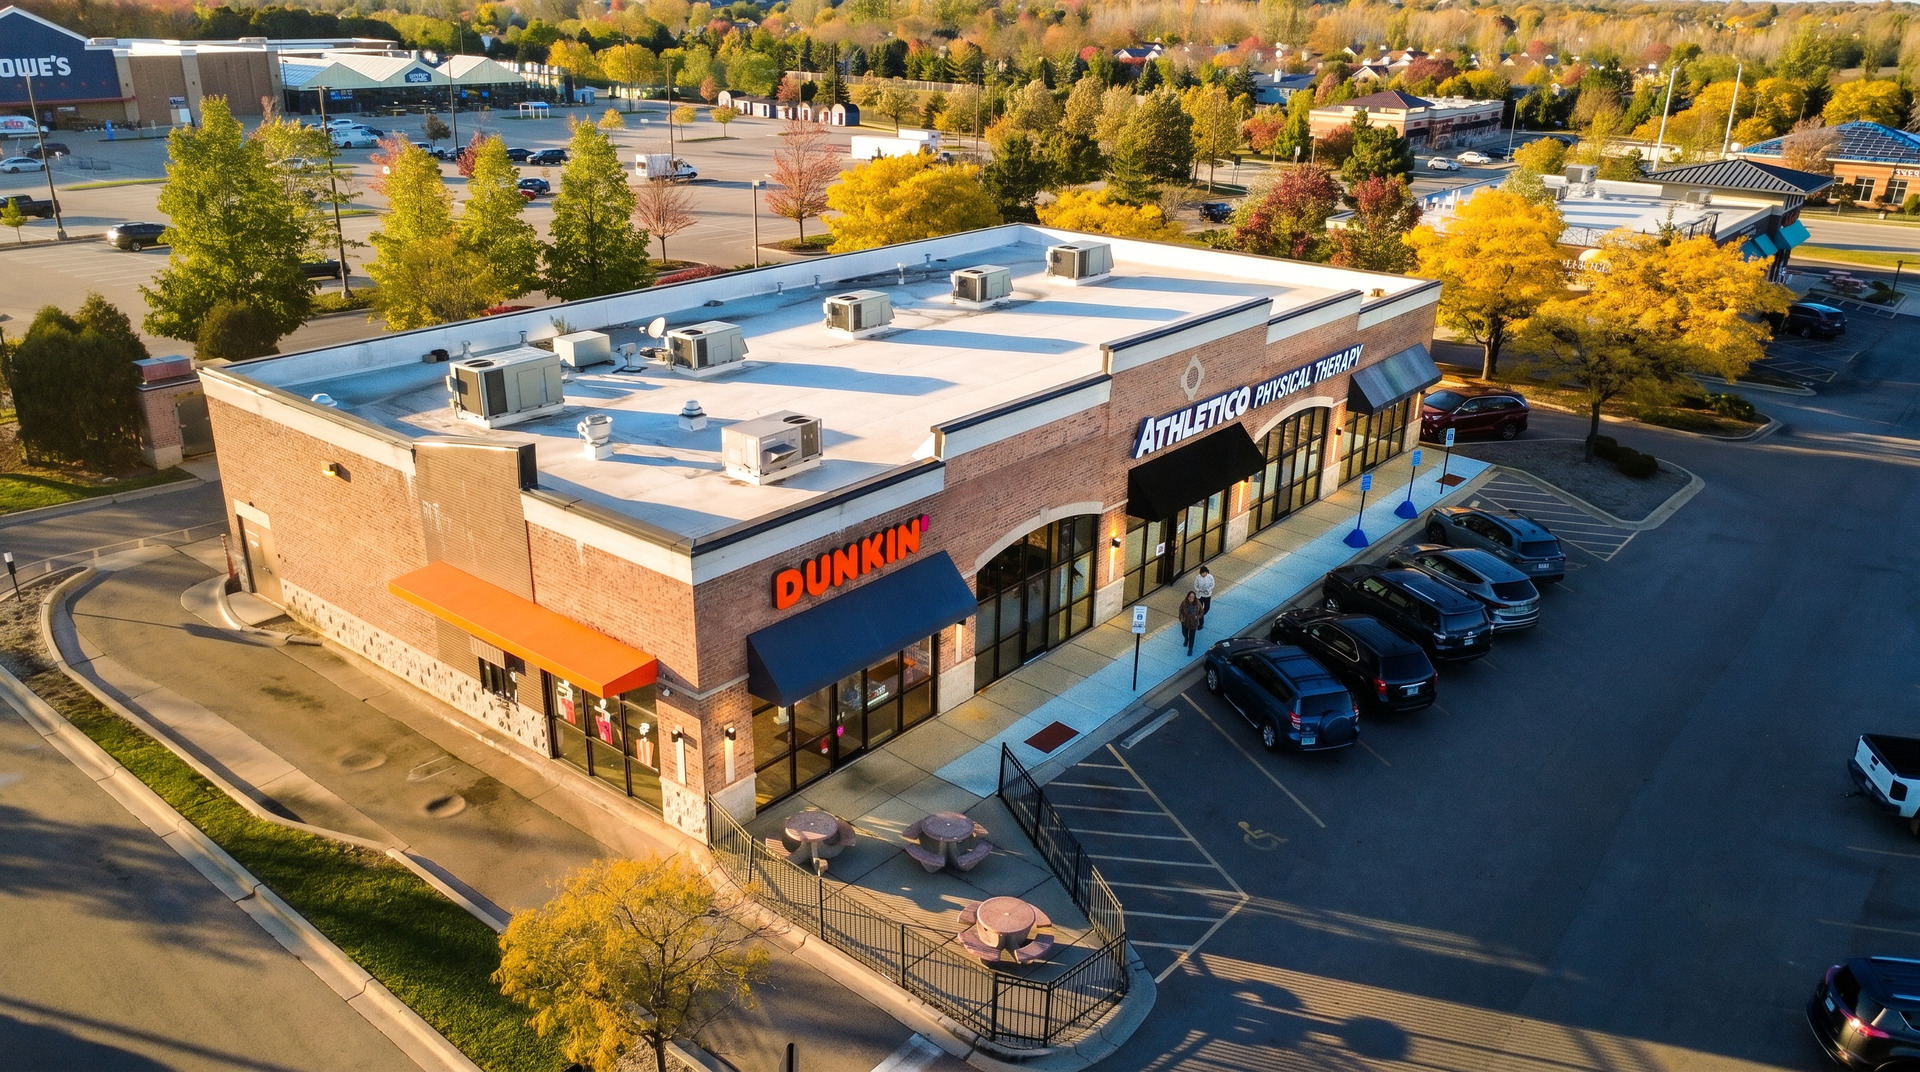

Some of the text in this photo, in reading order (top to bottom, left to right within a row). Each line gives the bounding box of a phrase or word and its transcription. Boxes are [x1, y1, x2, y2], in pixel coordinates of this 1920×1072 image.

[0, 55, 72, 78] OWE'S
[1134, 344, 1364, 459] ATHLETICO PHYSICAL THERAPY
[774, 514, 930, 610] DUNKIN'
